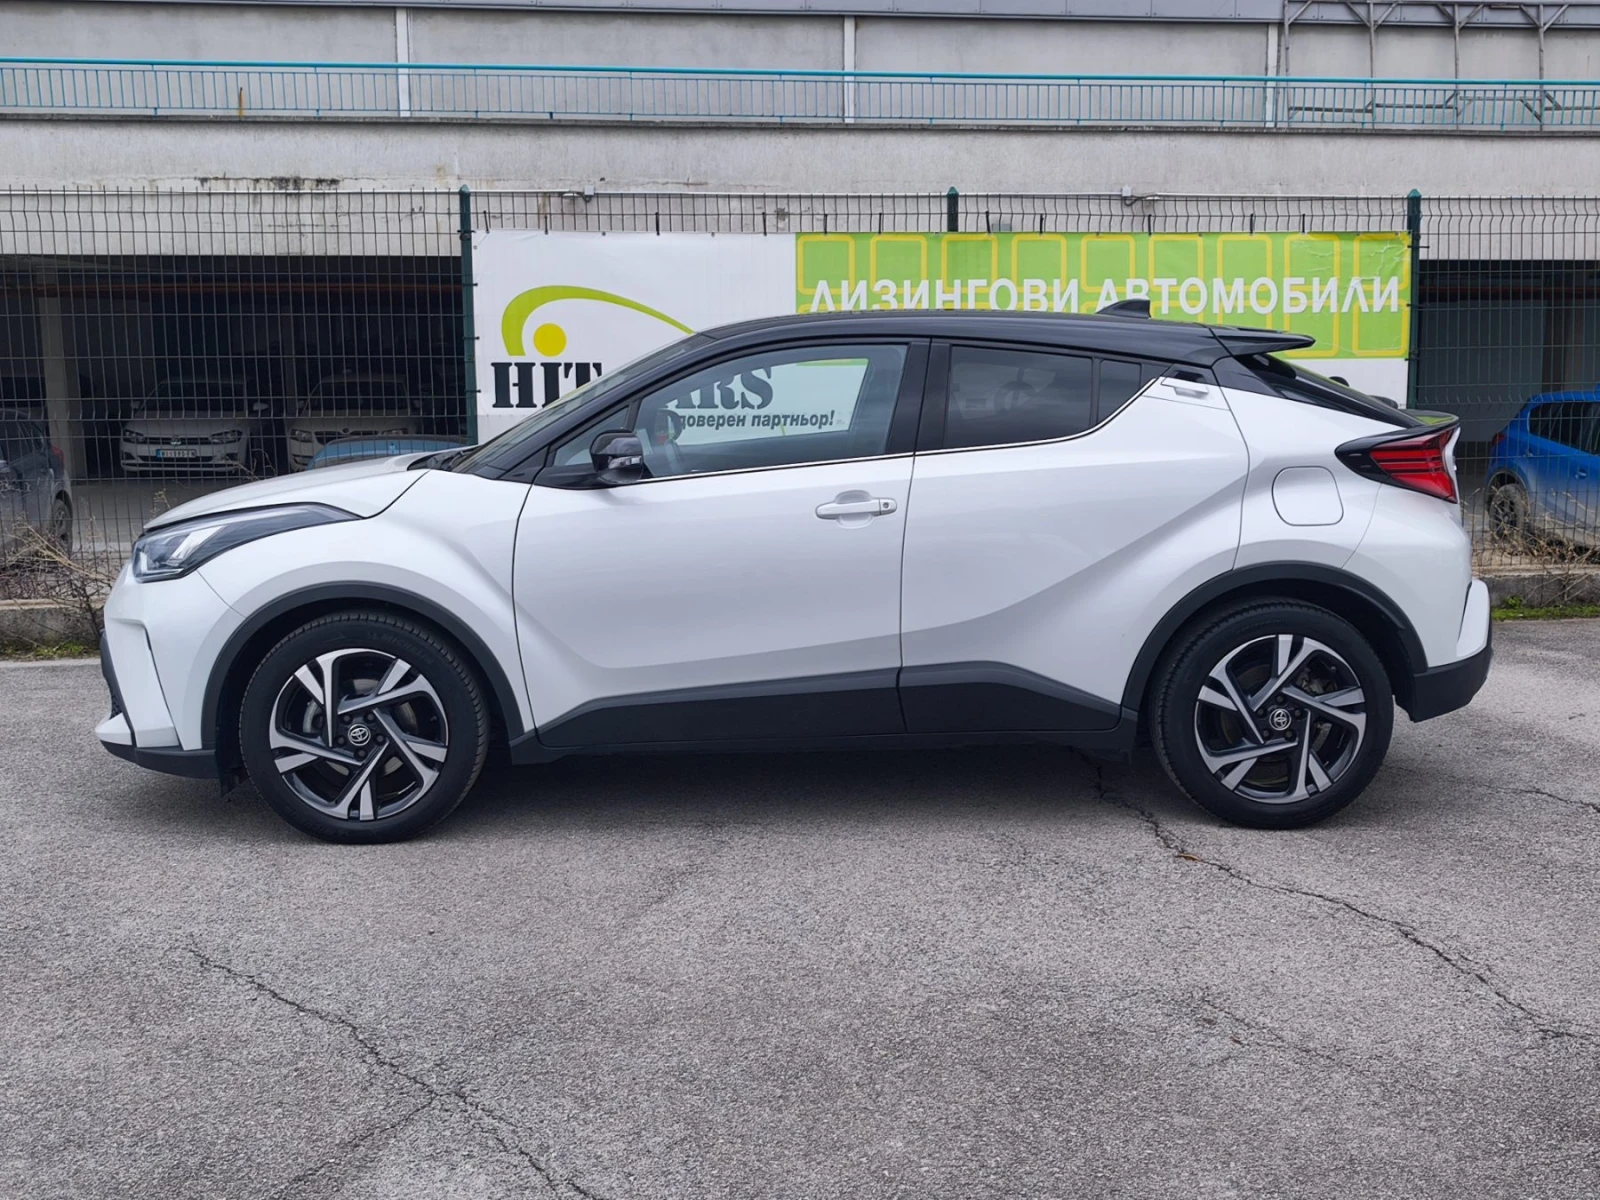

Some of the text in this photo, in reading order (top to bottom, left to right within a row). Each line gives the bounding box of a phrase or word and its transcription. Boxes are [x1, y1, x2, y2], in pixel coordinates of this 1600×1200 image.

[810, 276, 1398, 315] ЛИЗИНГОВИ АВТОМОБИЛИ
[491, 362, 602, 408] HIT
[751, 410, 835, 430] партньор!
